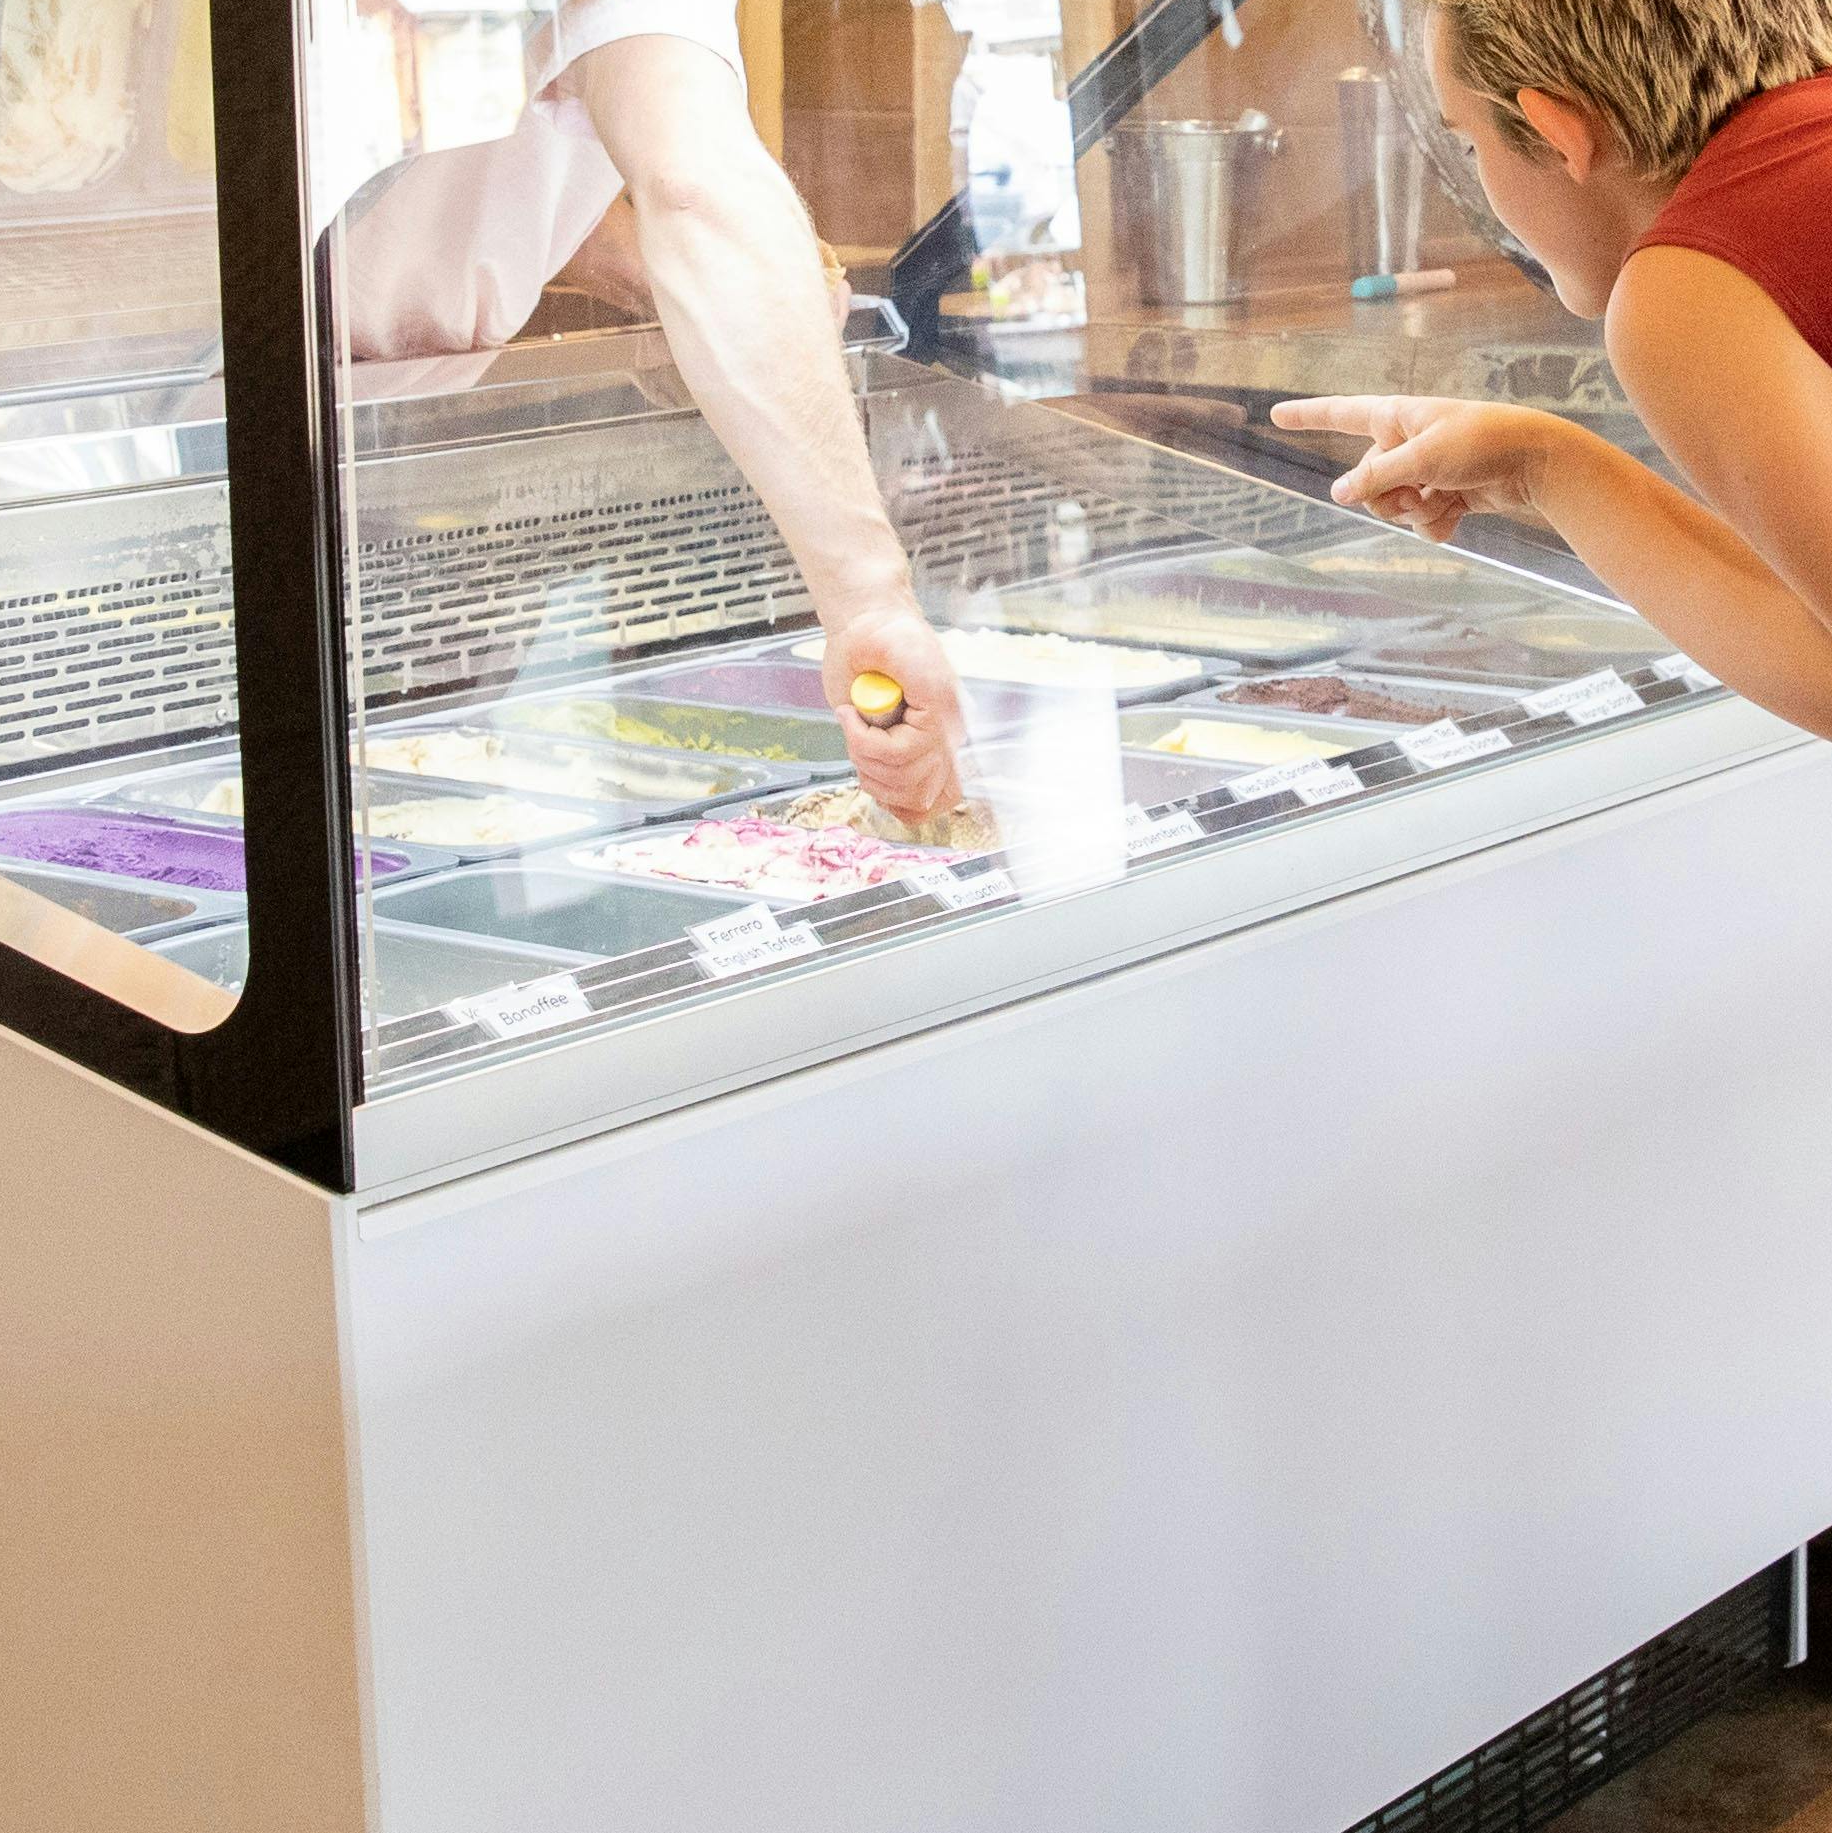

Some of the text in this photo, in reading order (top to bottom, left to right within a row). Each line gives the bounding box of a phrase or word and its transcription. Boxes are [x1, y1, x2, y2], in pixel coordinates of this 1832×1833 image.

[1277, 756, 1324, 782] Caramel
[1306, 775, 1356, 800] Tiramisu
[918, 871, 950, 887] Taro
[707, 917, 764, 946] Ferrero
[711, 930, 808, 970] English Toffee
[498, 991, 571, 1028] Banoffee
